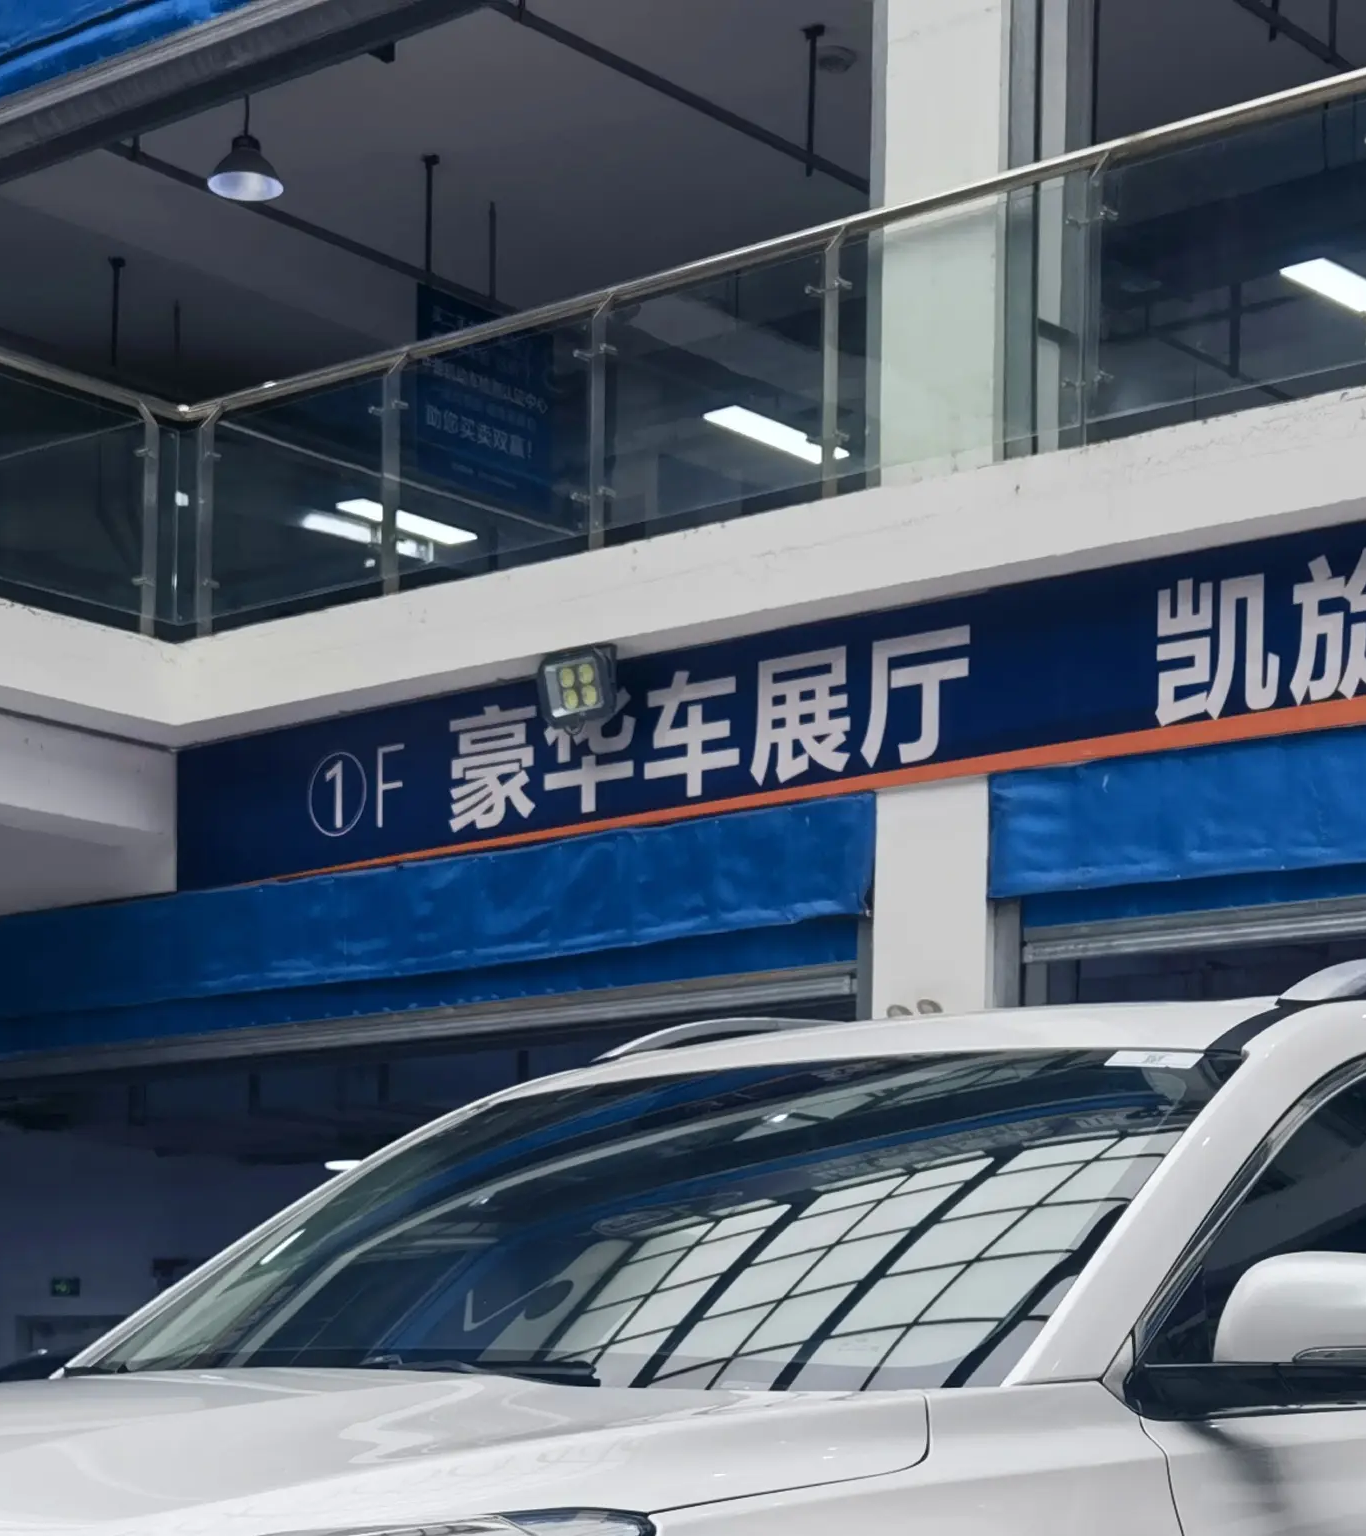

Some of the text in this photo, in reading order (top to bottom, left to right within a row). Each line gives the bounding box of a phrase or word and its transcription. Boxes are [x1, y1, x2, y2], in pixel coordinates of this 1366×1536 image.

[448, 625, 971, 834] 豪华车展厅
